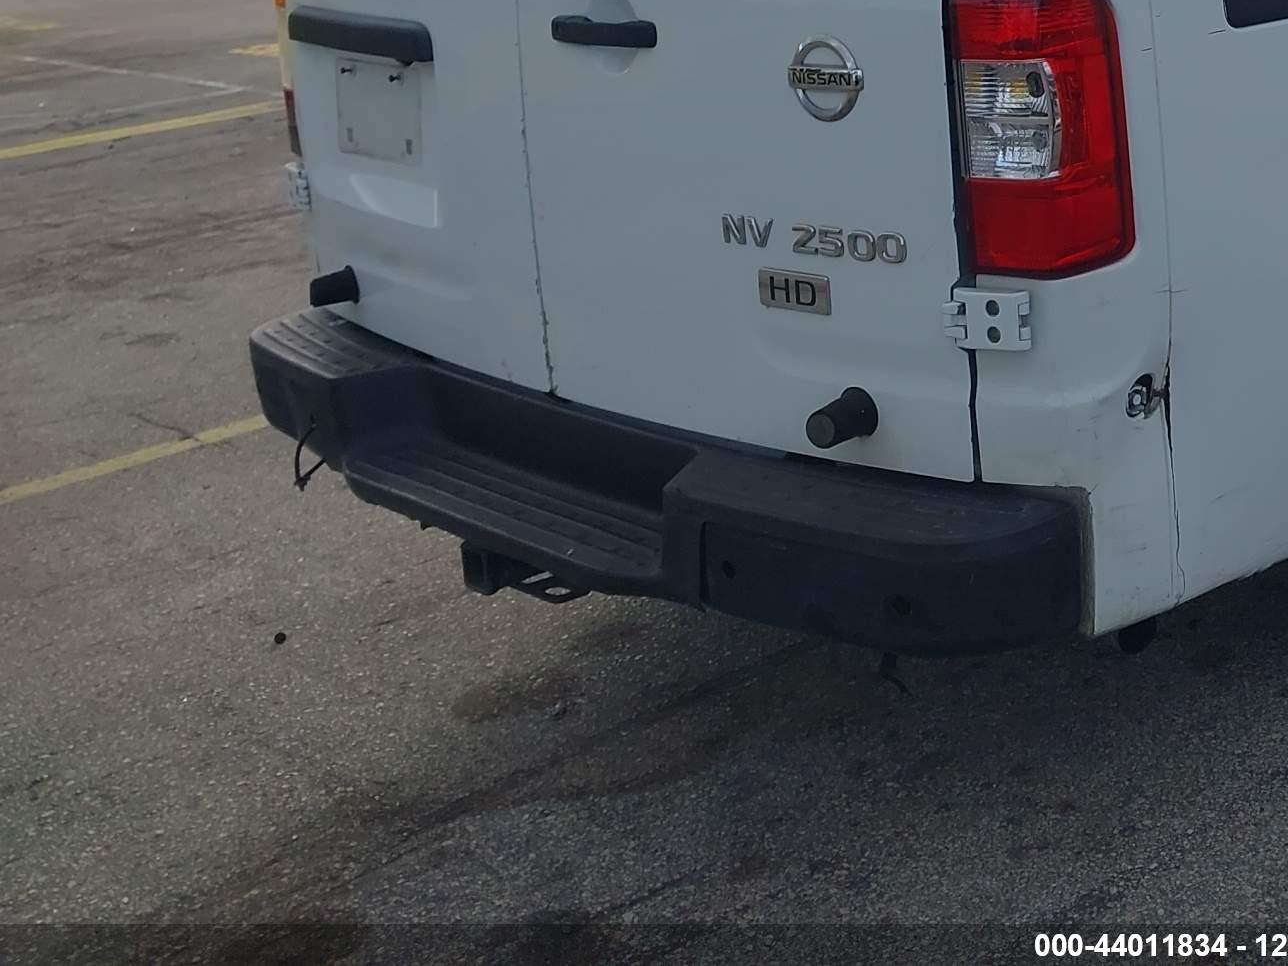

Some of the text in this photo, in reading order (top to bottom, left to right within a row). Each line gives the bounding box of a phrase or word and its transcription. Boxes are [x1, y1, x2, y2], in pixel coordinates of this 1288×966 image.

[791, 71, 852, 86] NISSAN
[721, 213, 907, 264] NV 2500
[769, 275, 817, 307] HD
